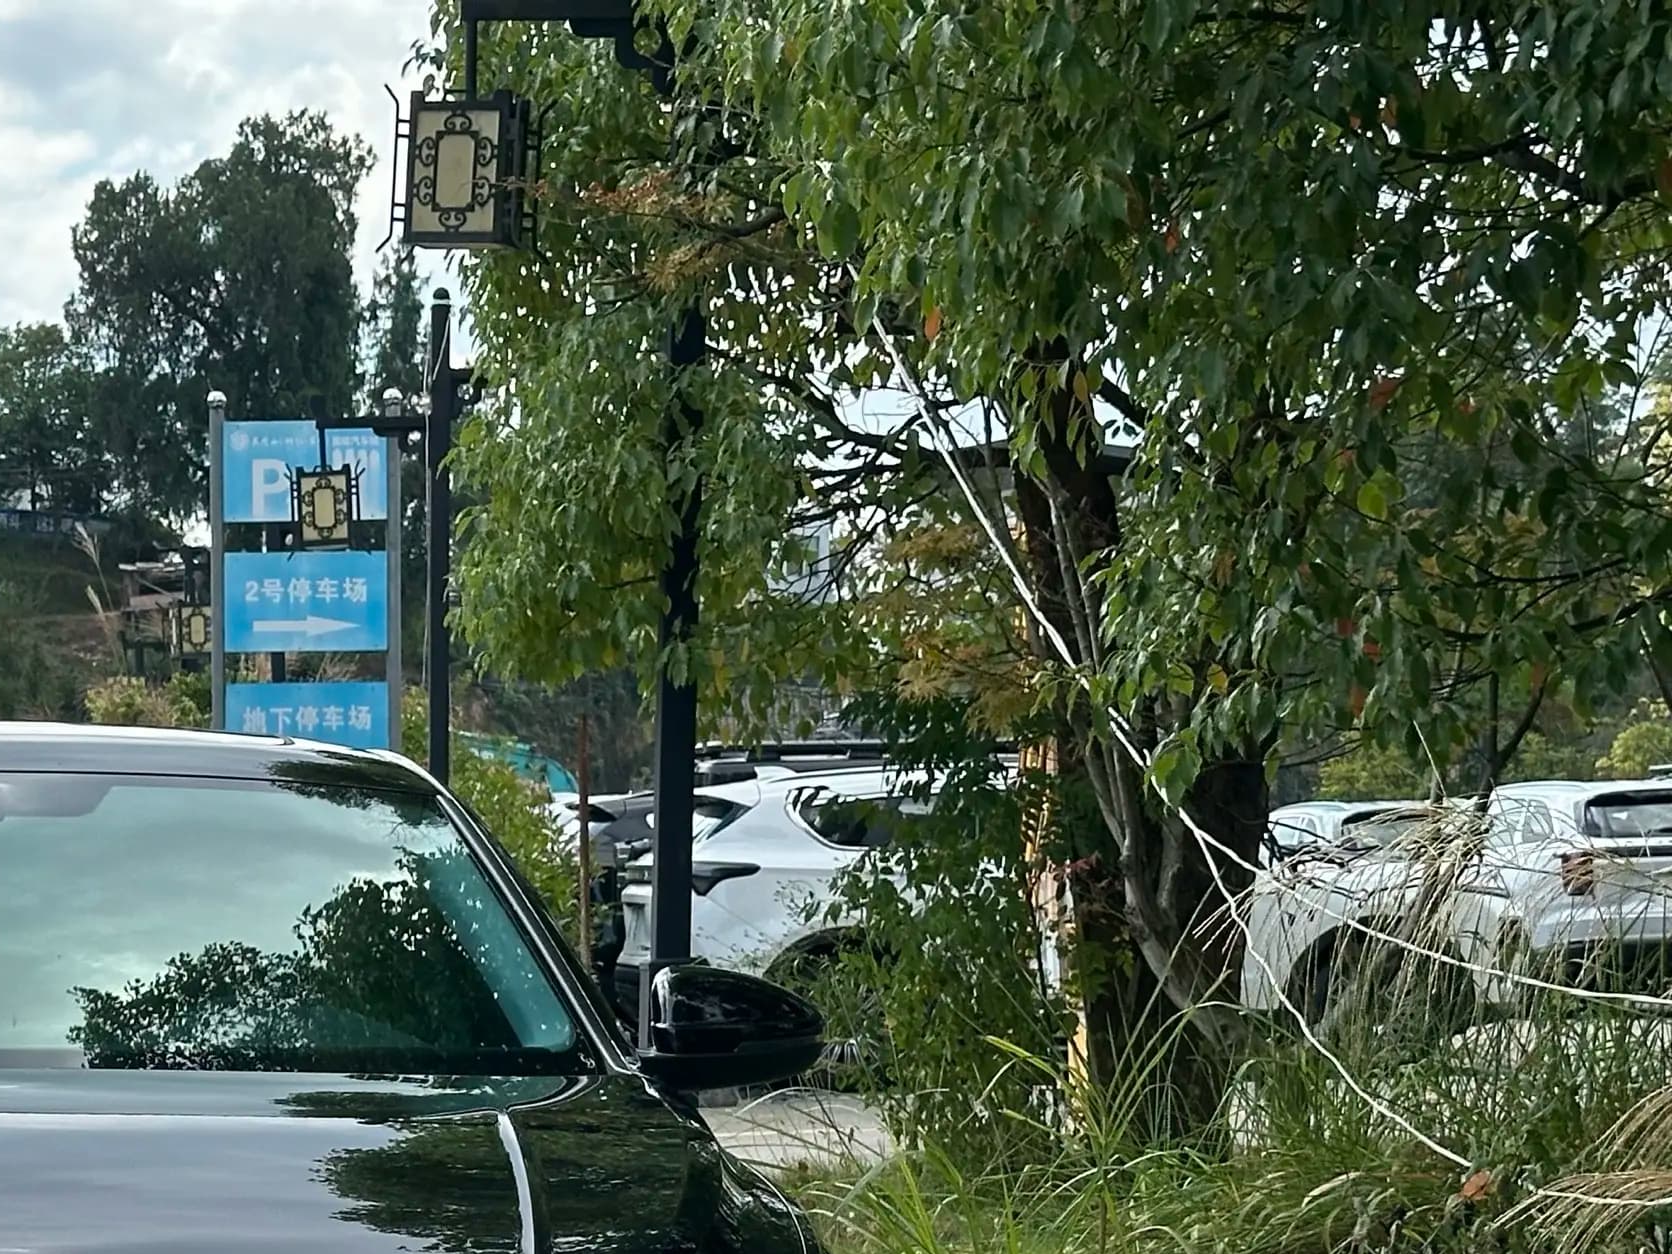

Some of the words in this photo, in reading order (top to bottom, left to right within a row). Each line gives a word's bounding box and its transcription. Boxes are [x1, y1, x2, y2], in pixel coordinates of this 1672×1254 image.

[244, 576, 368, 604] 2号停车场
[242, 705, 372, 738] 地下停车场
